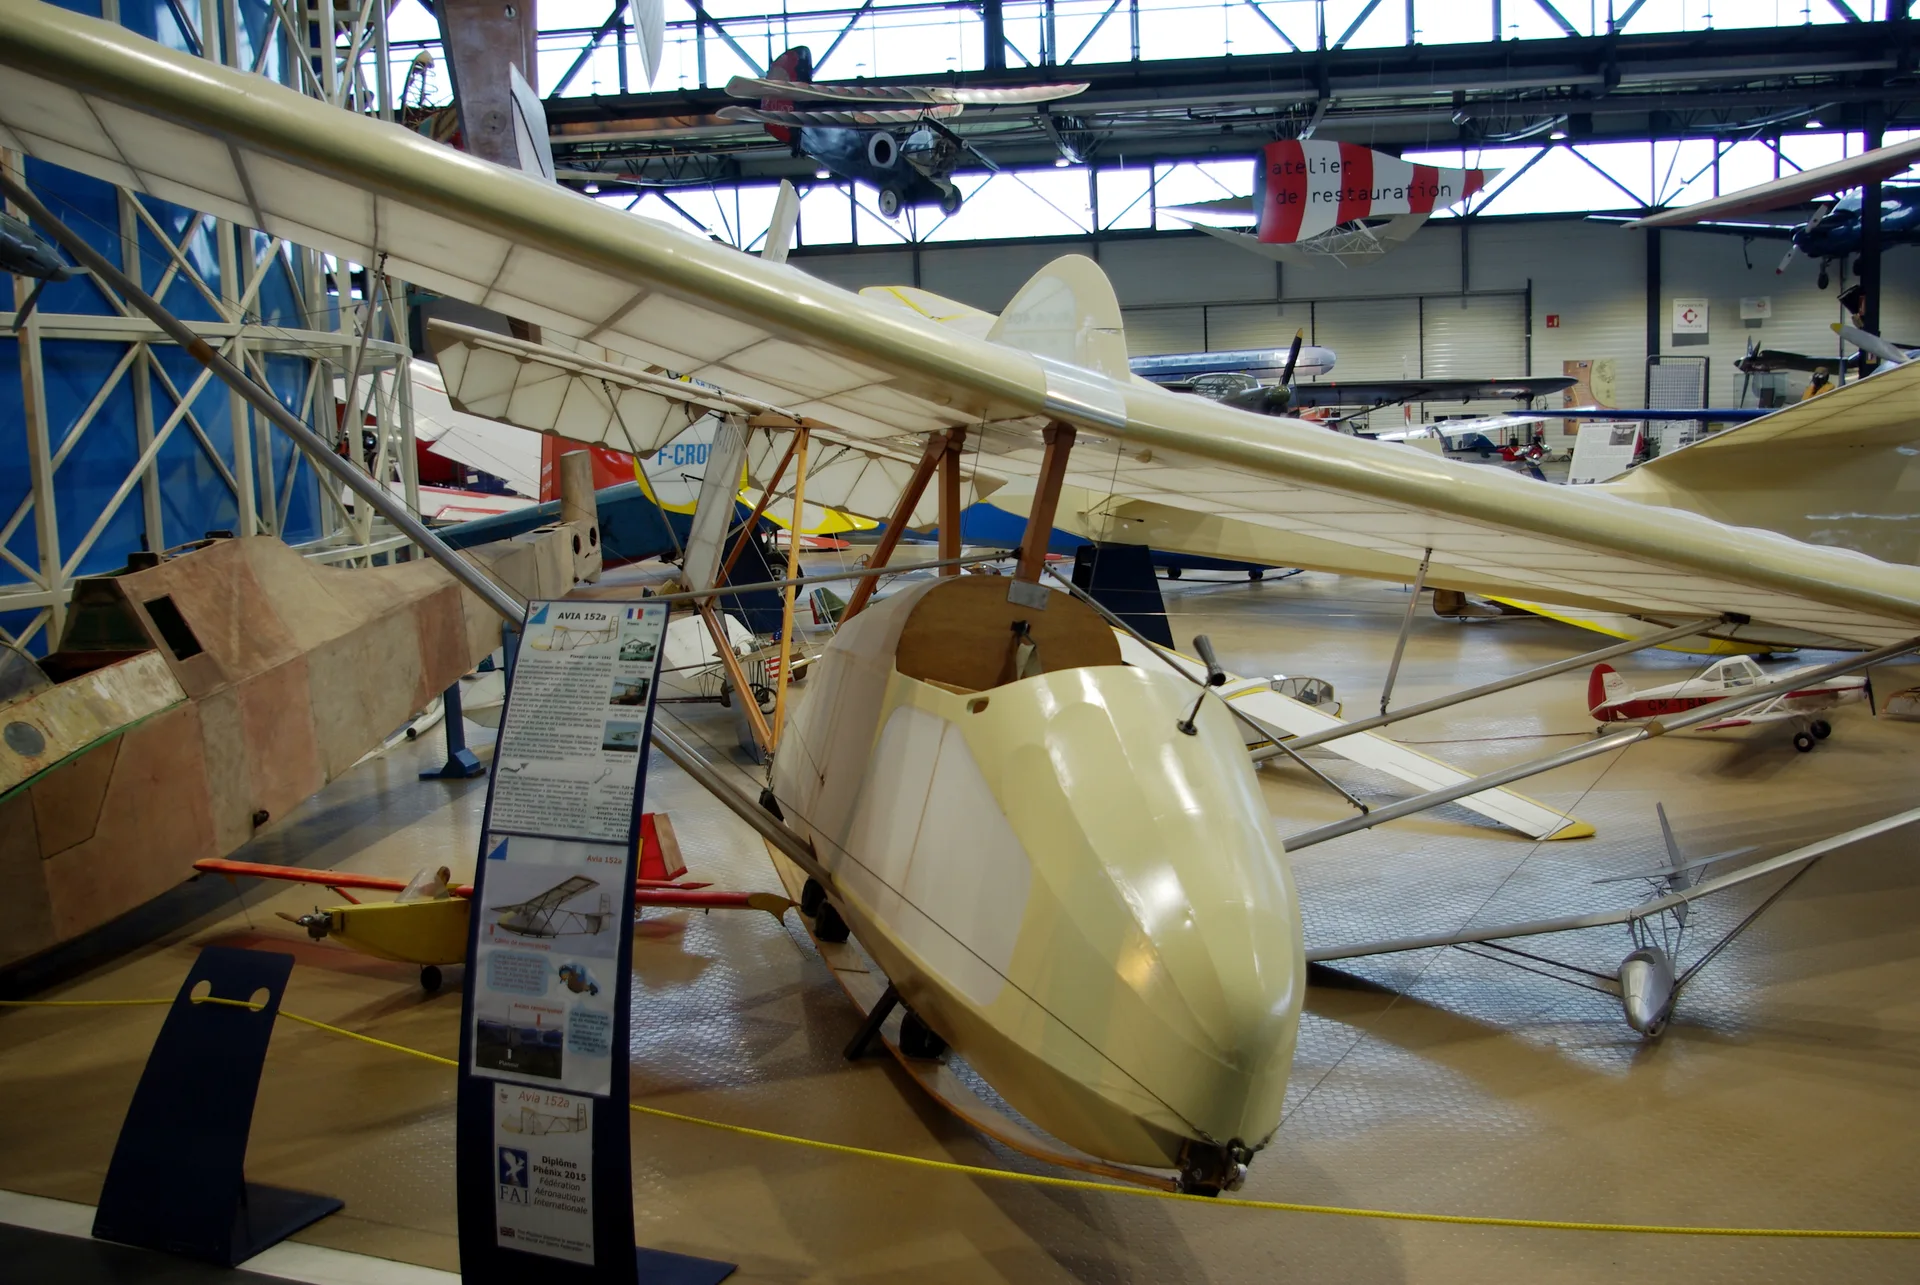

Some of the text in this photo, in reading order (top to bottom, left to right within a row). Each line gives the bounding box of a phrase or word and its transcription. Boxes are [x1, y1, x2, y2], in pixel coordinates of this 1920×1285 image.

[1272, 158, 1351, 175] atelier
[1276, 182, 1451, 205] de restauration
[658, 444, 712, 465] F-CRO
[557, 612, 606, 621] AVIA 152a
[586, 854, 622, 865] Avia 152a
[518, 1090, 570, 1108] Avia 152a
[541, 1155, 577, 1169] Diplôme
[533, 1165, 586, 1182] Phénix 2015
[540, 1177, 580, 1192] Fédération
[500, 1186, 529, 1205] FAI
[534, 1187, 586, 1203] Aéronautique
[533, 1198, 588, 1215] Internationale
